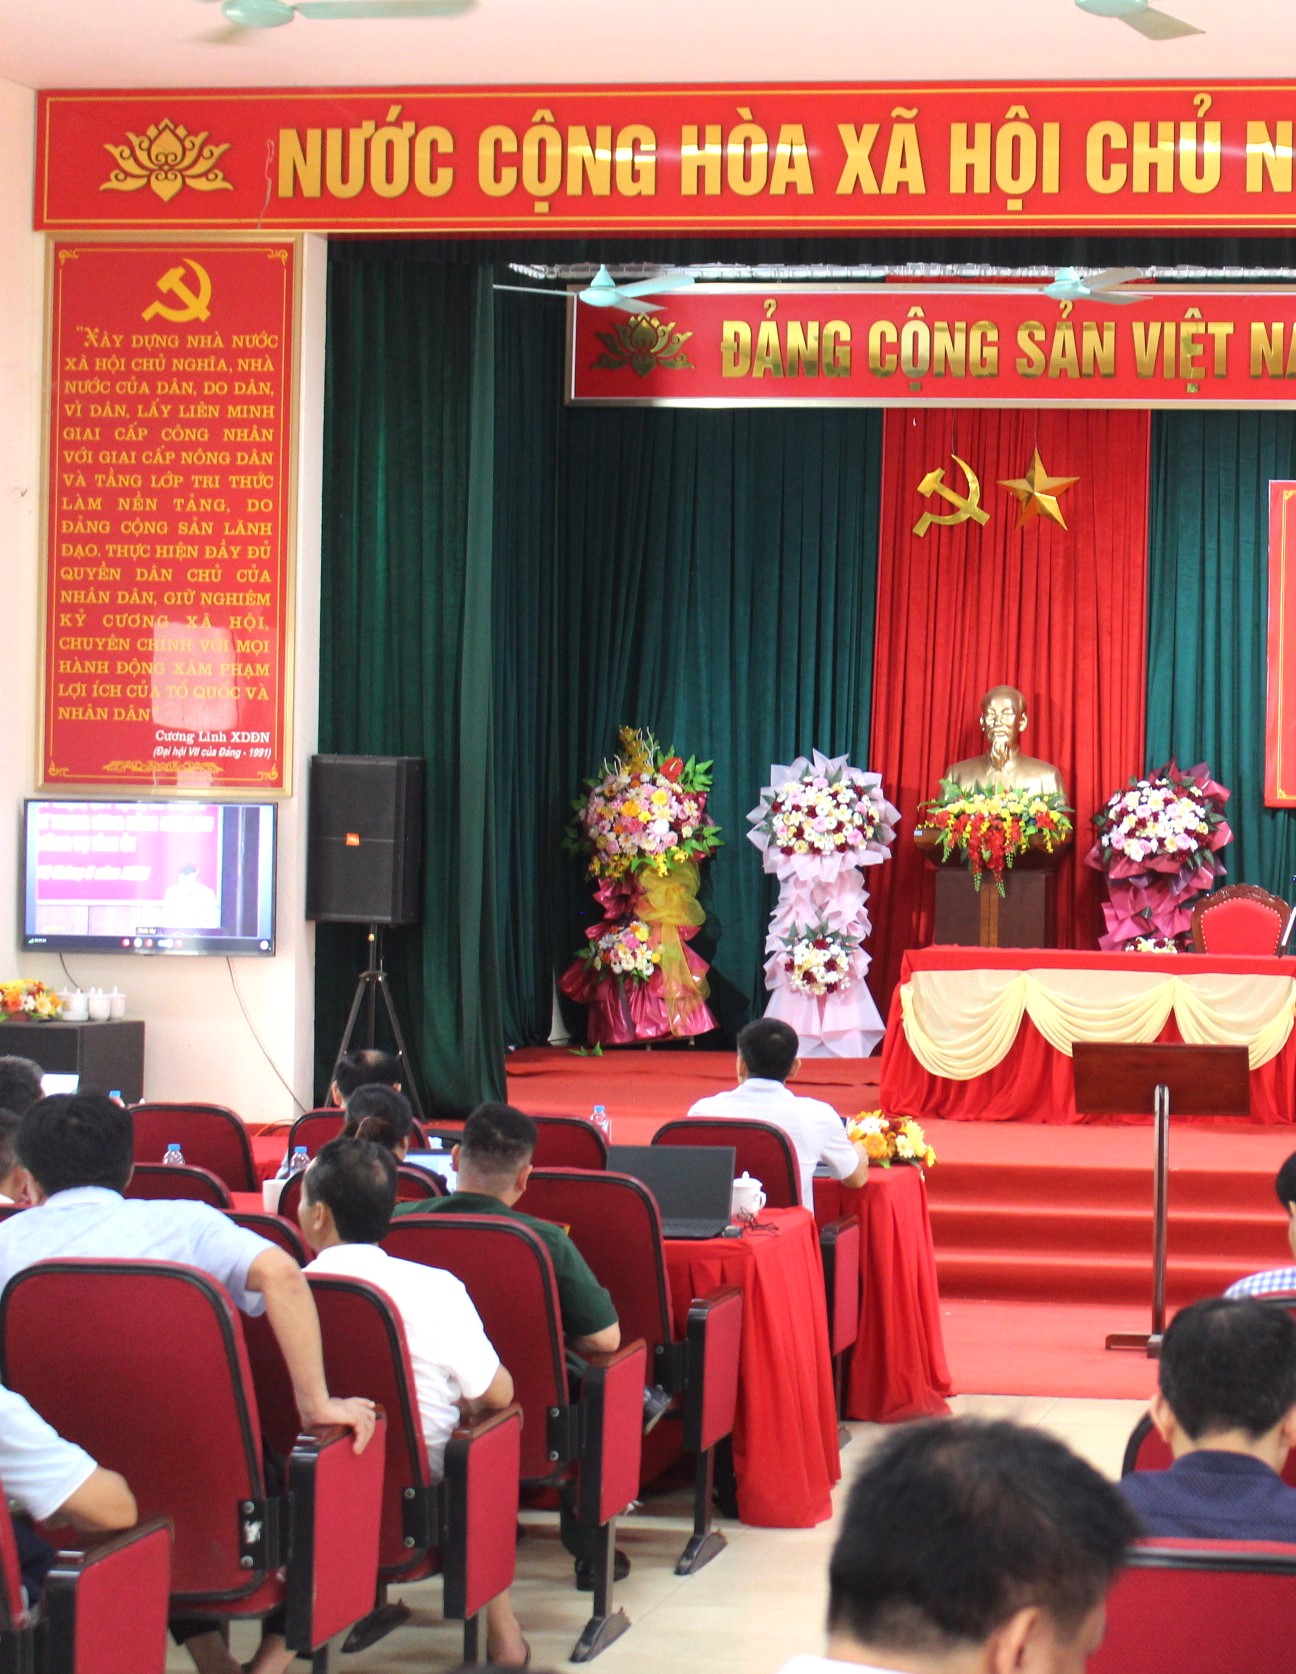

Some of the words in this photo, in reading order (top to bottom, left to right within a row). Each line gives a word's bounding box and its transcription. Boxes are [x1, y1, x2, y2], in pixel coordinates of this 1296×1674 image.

[277, 105, 454, 199] NƯỚC
[477, 108, 658, 213] CỘNG
[680, 107, 814, 196] HÒA
[835, 106, 927, 195] XÃ
[949, 105, 1060, 211] HỘI
[1085, 94, 1223, 194] CHỦ
[720, 298, 851, 379] ĐẢNG
[867, 306, 998, 392] CỘNG
[1016, 300, 1116, 379] SẢN
[1132, 307, 1234, 392] VIỆT
[64, 378, 111, 395] NƯỚC
[115, 376, 151, 395] CỦA
[203, 380, 229, 396] DO
[64, 402, 82, 416] VÌ
[179, 400, 220, 418] LIÊN
[227, 404, 275, 420] MINH
[63, 426, 101, 441] GIAI
[114, 422, 149, 441] CẤP
[161, 424, 209, 442] CÔNG
[224, 424, 274, 442] NHÂN
[62, 497, 102, 510] LÀM
[247, 498, 274, 512] DO
[61, 515, 110, 534] ĐẢNG
[120, 518, 169, 536] CỘNG
[178, 517, 213, 536] SẢN
[224, 519, 272, 536] LÃNH
[60, 561, 121, 581] QUYỀN
[136, 565, 173, 582] DÂN
[187, 563, 223, 582] CHỦ
[236, 564, 272, 583] CỦA
[156, 730, 195, 744] Cương
